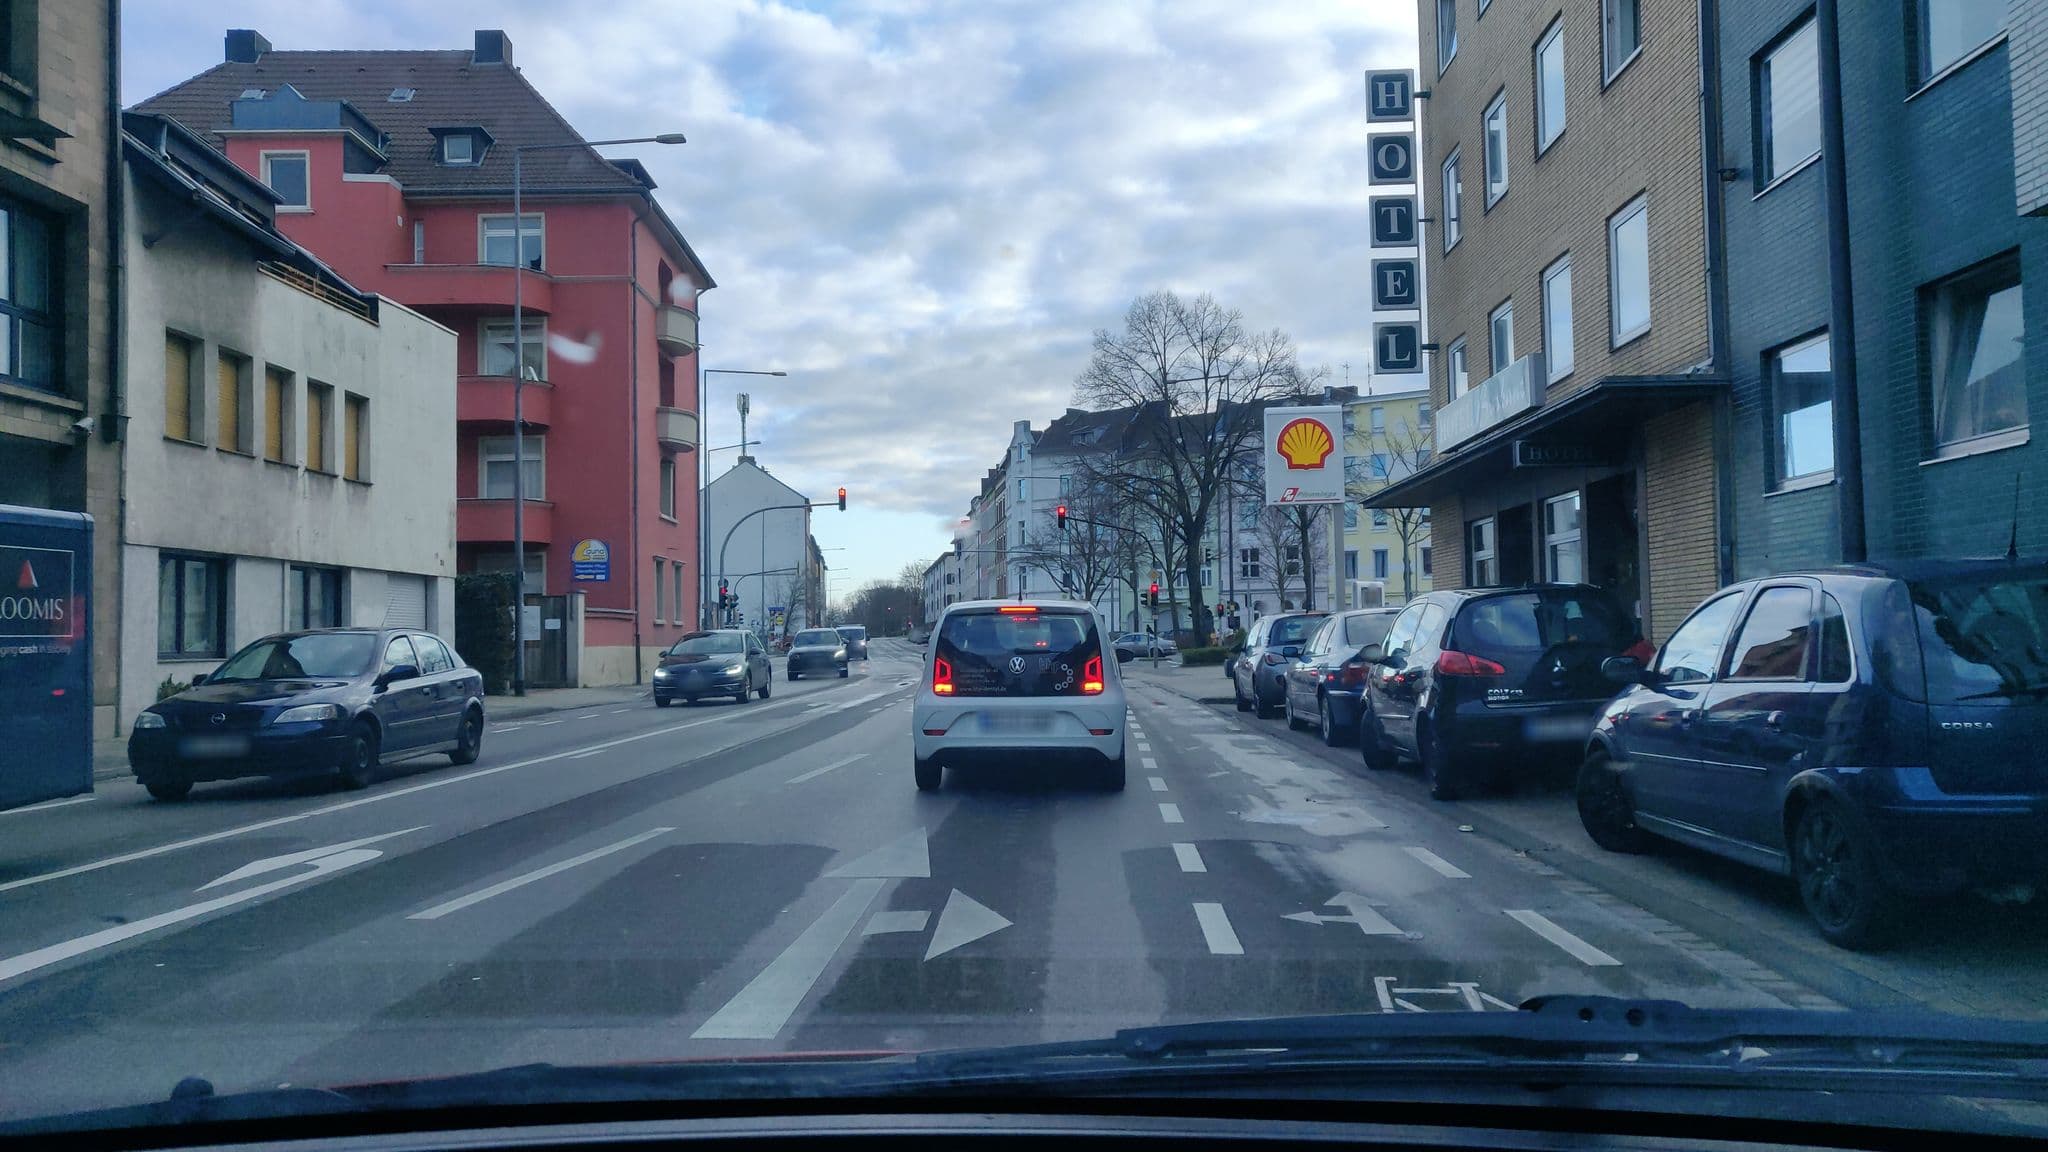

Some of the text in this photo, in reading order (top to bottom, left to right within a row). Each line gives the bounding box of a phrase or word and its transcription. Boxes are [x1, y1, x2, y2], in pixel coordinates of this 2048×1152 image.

[1375, 81, 1411, 362] HOTEL
[0, 596, 64, 620] OOMIS
[1941, 722, 1993, 730] CORSA
